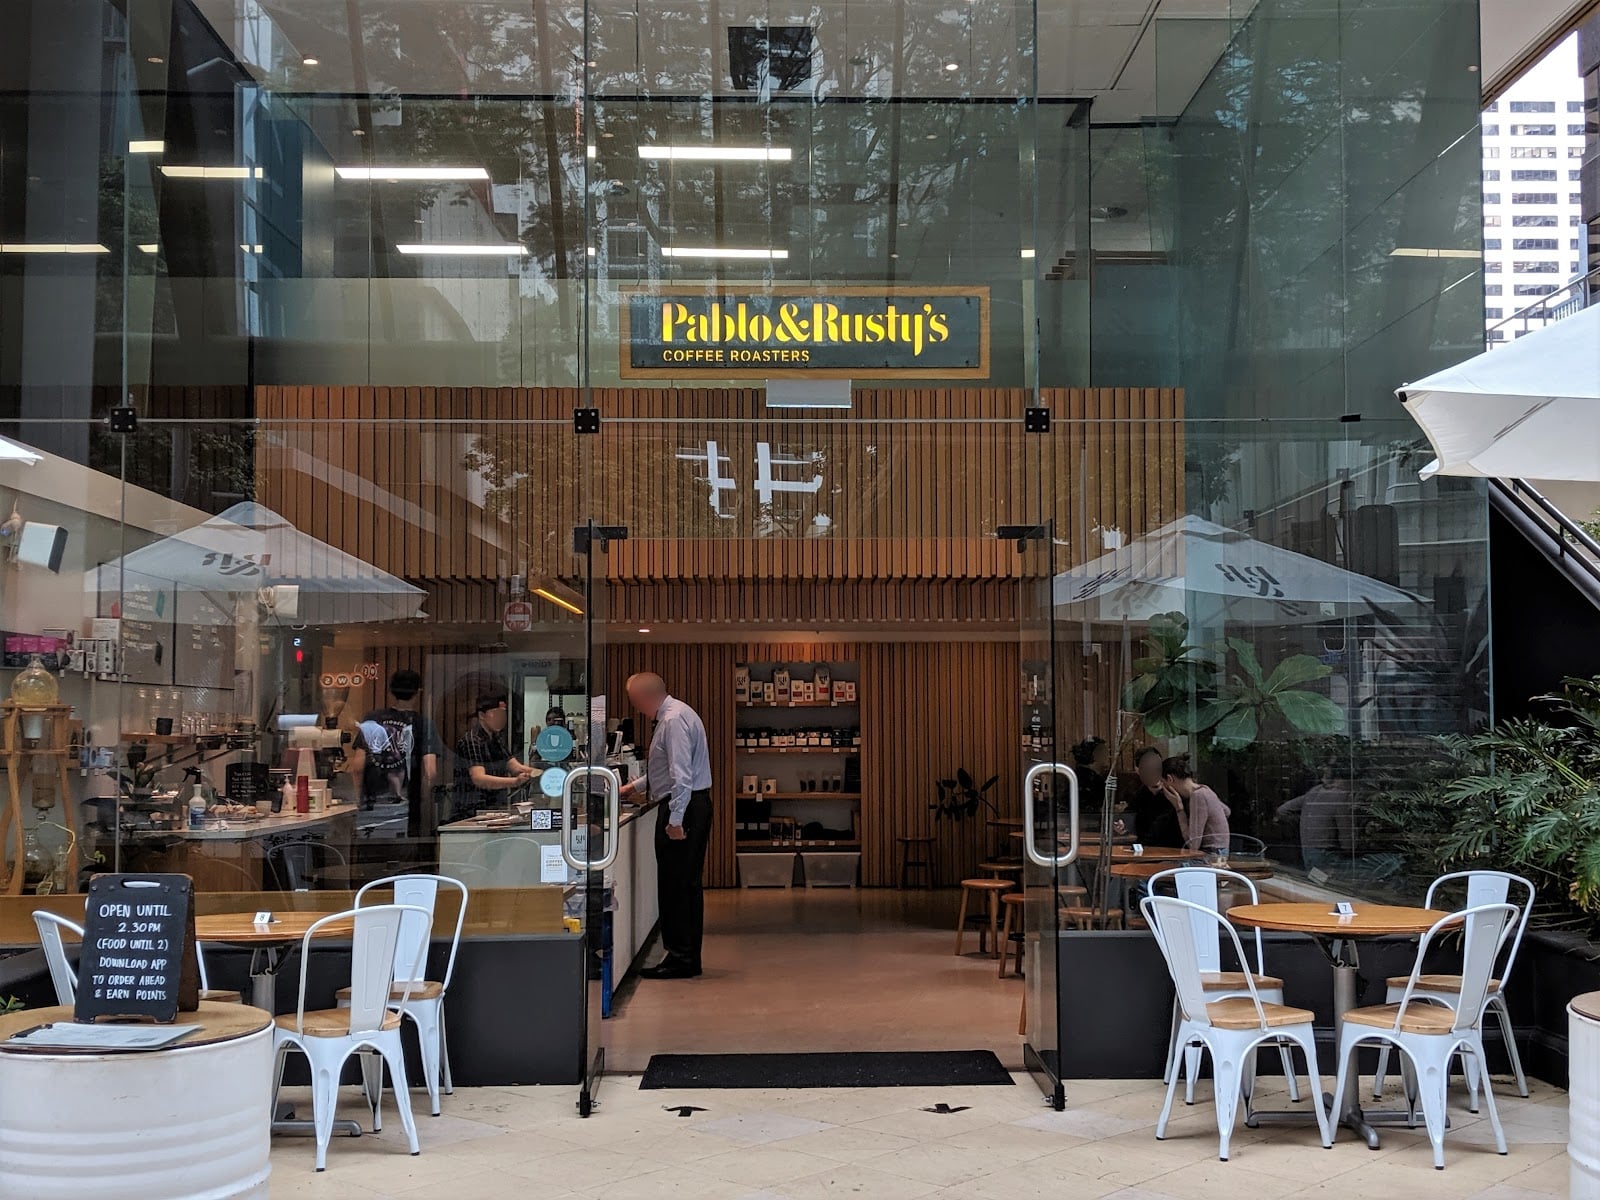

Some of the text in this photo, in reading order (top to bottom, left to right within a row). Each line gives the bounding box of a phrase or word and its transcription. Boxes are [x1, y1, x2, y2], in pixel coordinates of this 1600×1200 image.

[662, 302, 949, 356] Pablo&Rusty's
[663, 350, 810, 362] COFFEE ROASTERS
[99, 904, 172, 918] OPEN UNTIL
[118, 922, 161, 933] 2.30PM
[96, 938, 169, 950] (FOOD UNTIL 2)
[99, 956, 167, 971] DOWNLOAD APP
[92, 974, 166, 986] TO ORDER AHEAD
[106, 988, 130, 1000] EARN
[135, 988, 167, 1001] POINTS
